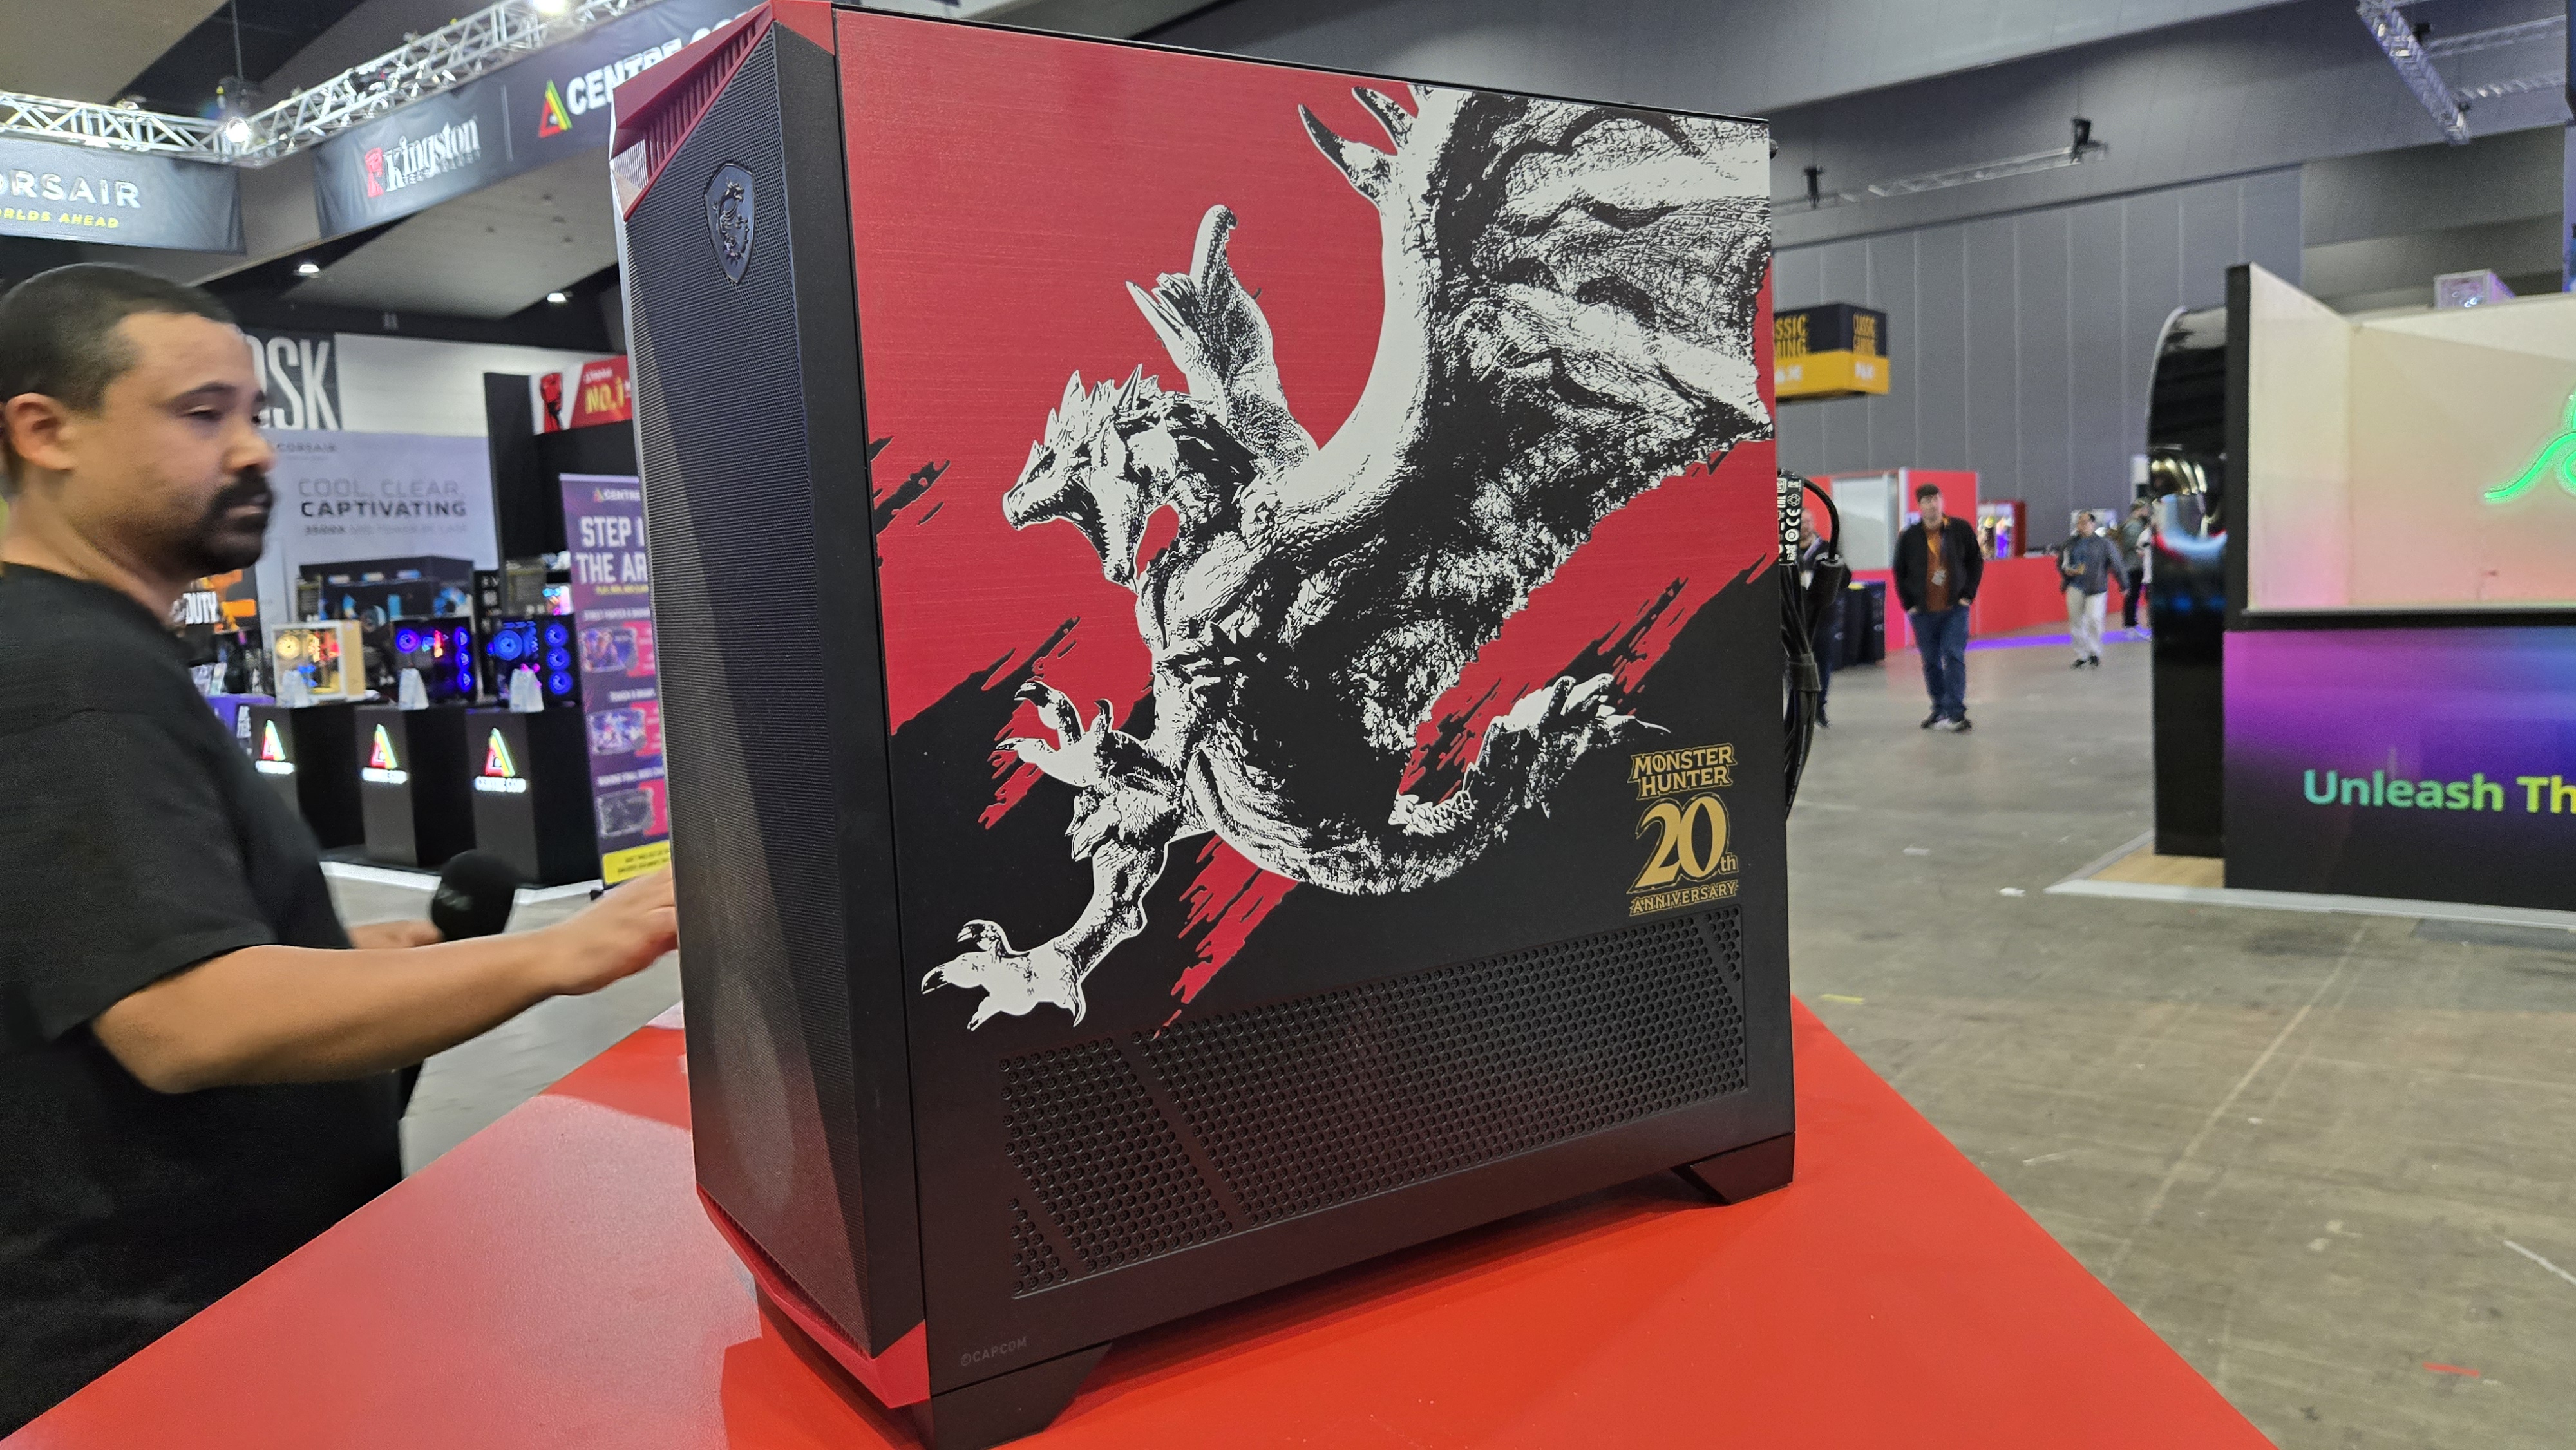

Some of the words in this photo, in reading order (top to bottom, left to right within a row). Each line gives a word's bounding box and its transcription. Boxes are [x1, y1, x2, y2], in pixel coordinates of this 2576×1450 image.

[383, 118, 481, 192] Kingston
[0, 169, 141, 209] RSAIR
[0, 207, 52, 223] RLDS
[59, 212, 119, 229] AHEAD
[301, 500, 467, 518] CAPTIVATING
[581, 516, 632, 547] STEP
[575, 552, 616, 585] THE
[184, 591, 220, 625] DUTY
[1630, 744, 1736, 782] MONSTER
[1639, 766, 1732, 798] HUNTER
[2303, 769, 2505, 812] Unleash
[2515, 775, 2576, 814] Th
[1631, 881, 1738, 914] ANNIVERSARY
